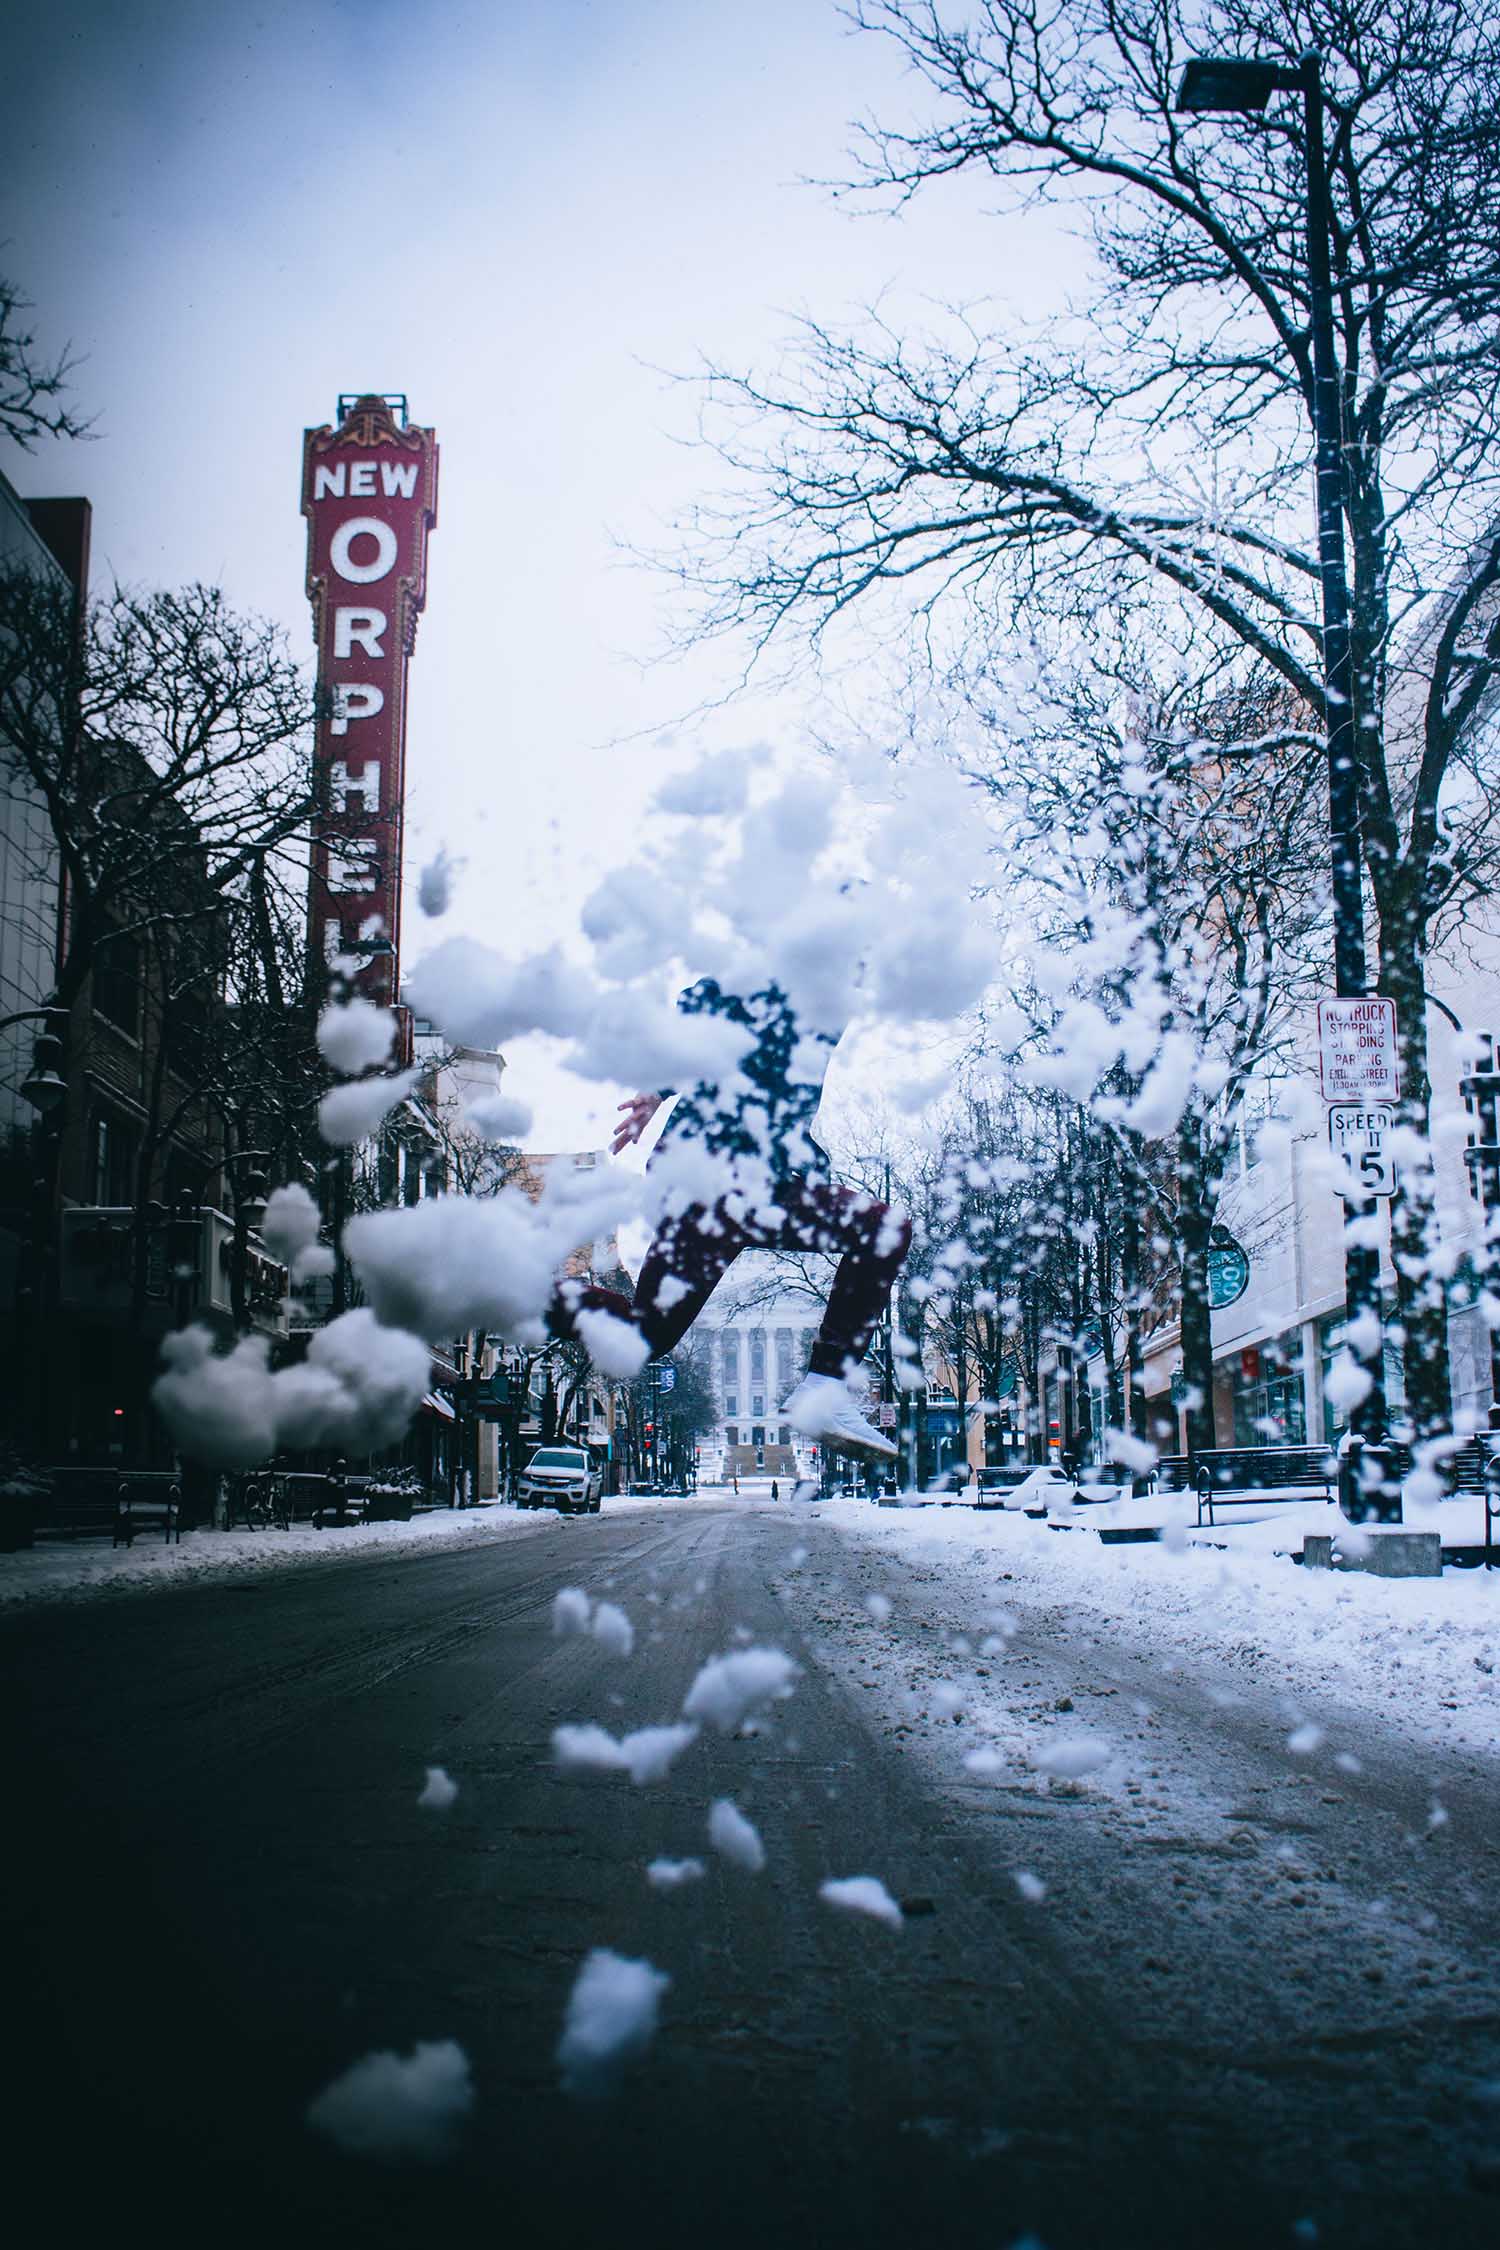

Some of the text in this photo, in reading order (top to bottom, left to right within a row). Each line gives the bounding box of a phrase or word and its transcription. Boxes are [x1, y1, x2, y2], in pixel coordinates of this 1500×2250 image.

[314, 460, 418, 500] NEW
[317, 517, 399, 1053] ORPHEU
[1335, 1113, 1387, 1130] SPEED
